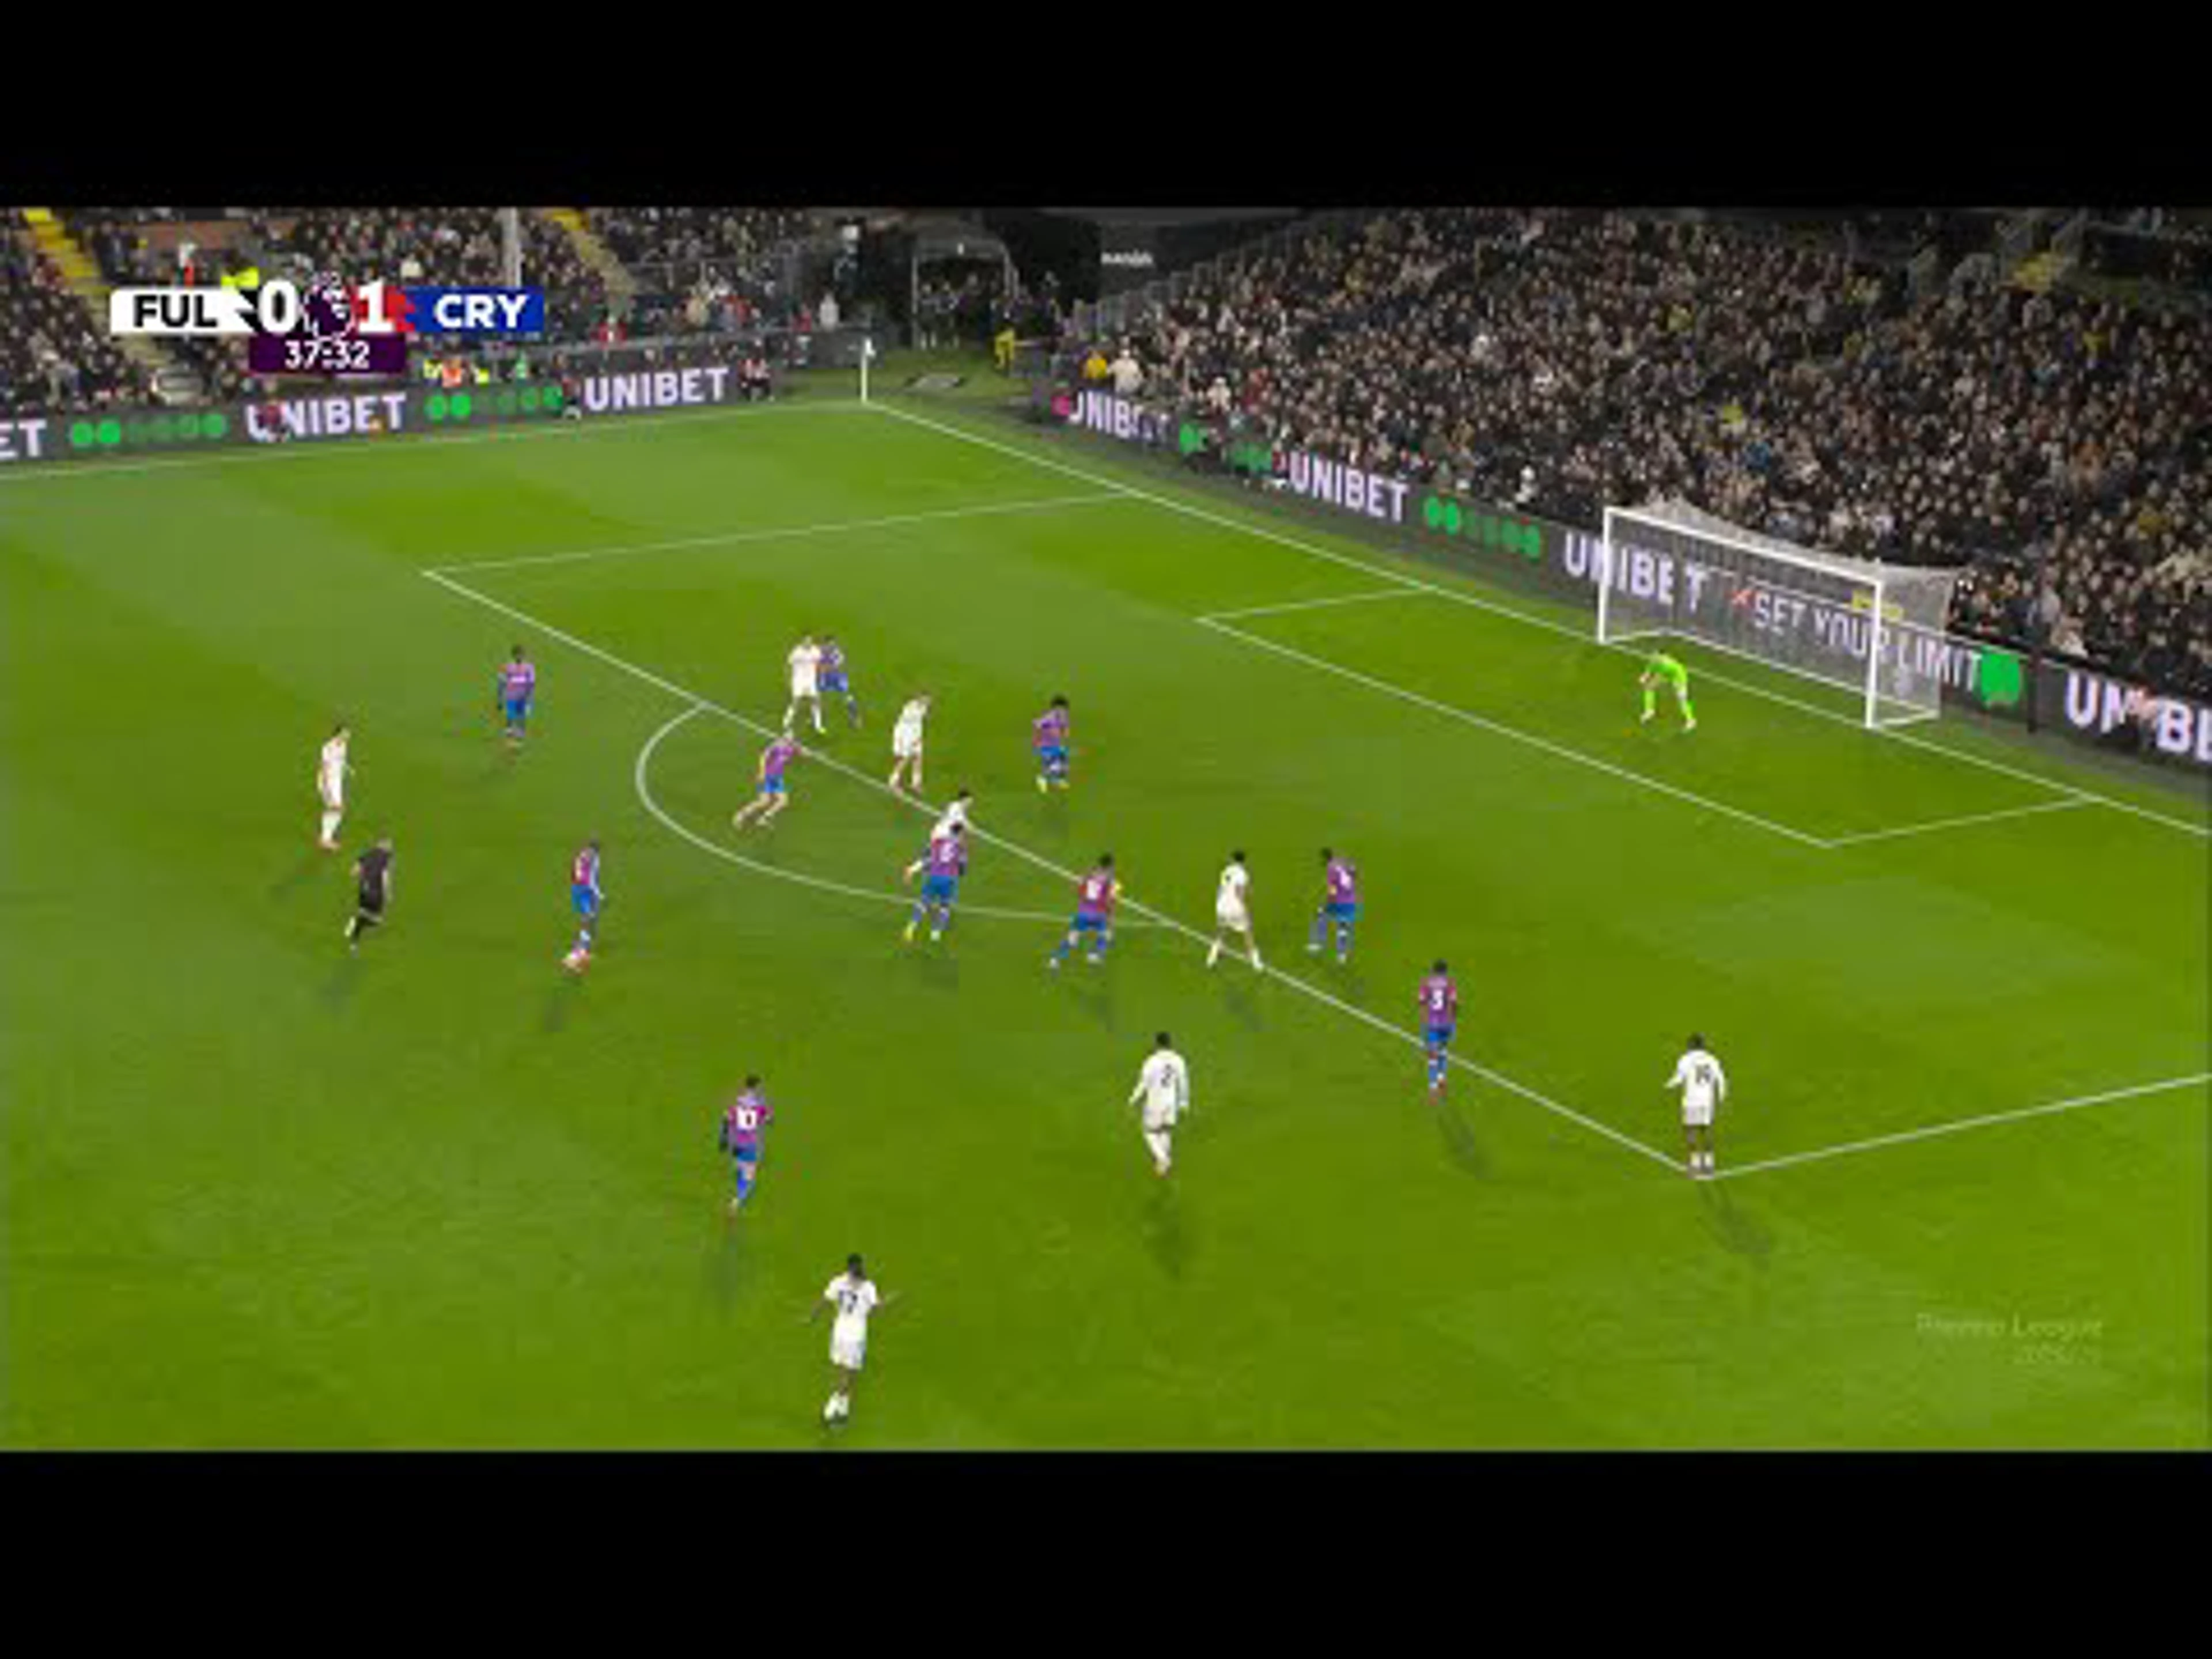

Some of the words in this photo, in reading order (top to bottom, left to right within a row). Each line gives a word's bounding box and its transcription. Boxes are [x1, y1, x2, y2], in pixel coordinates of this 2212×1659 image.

[584, 367, 729, 411] UNIBET
[1290, 452, 1410, 522] UNIBET
[1753, 589, 1808, 635] SET
[2067, 670, 2212, 762] UNB
